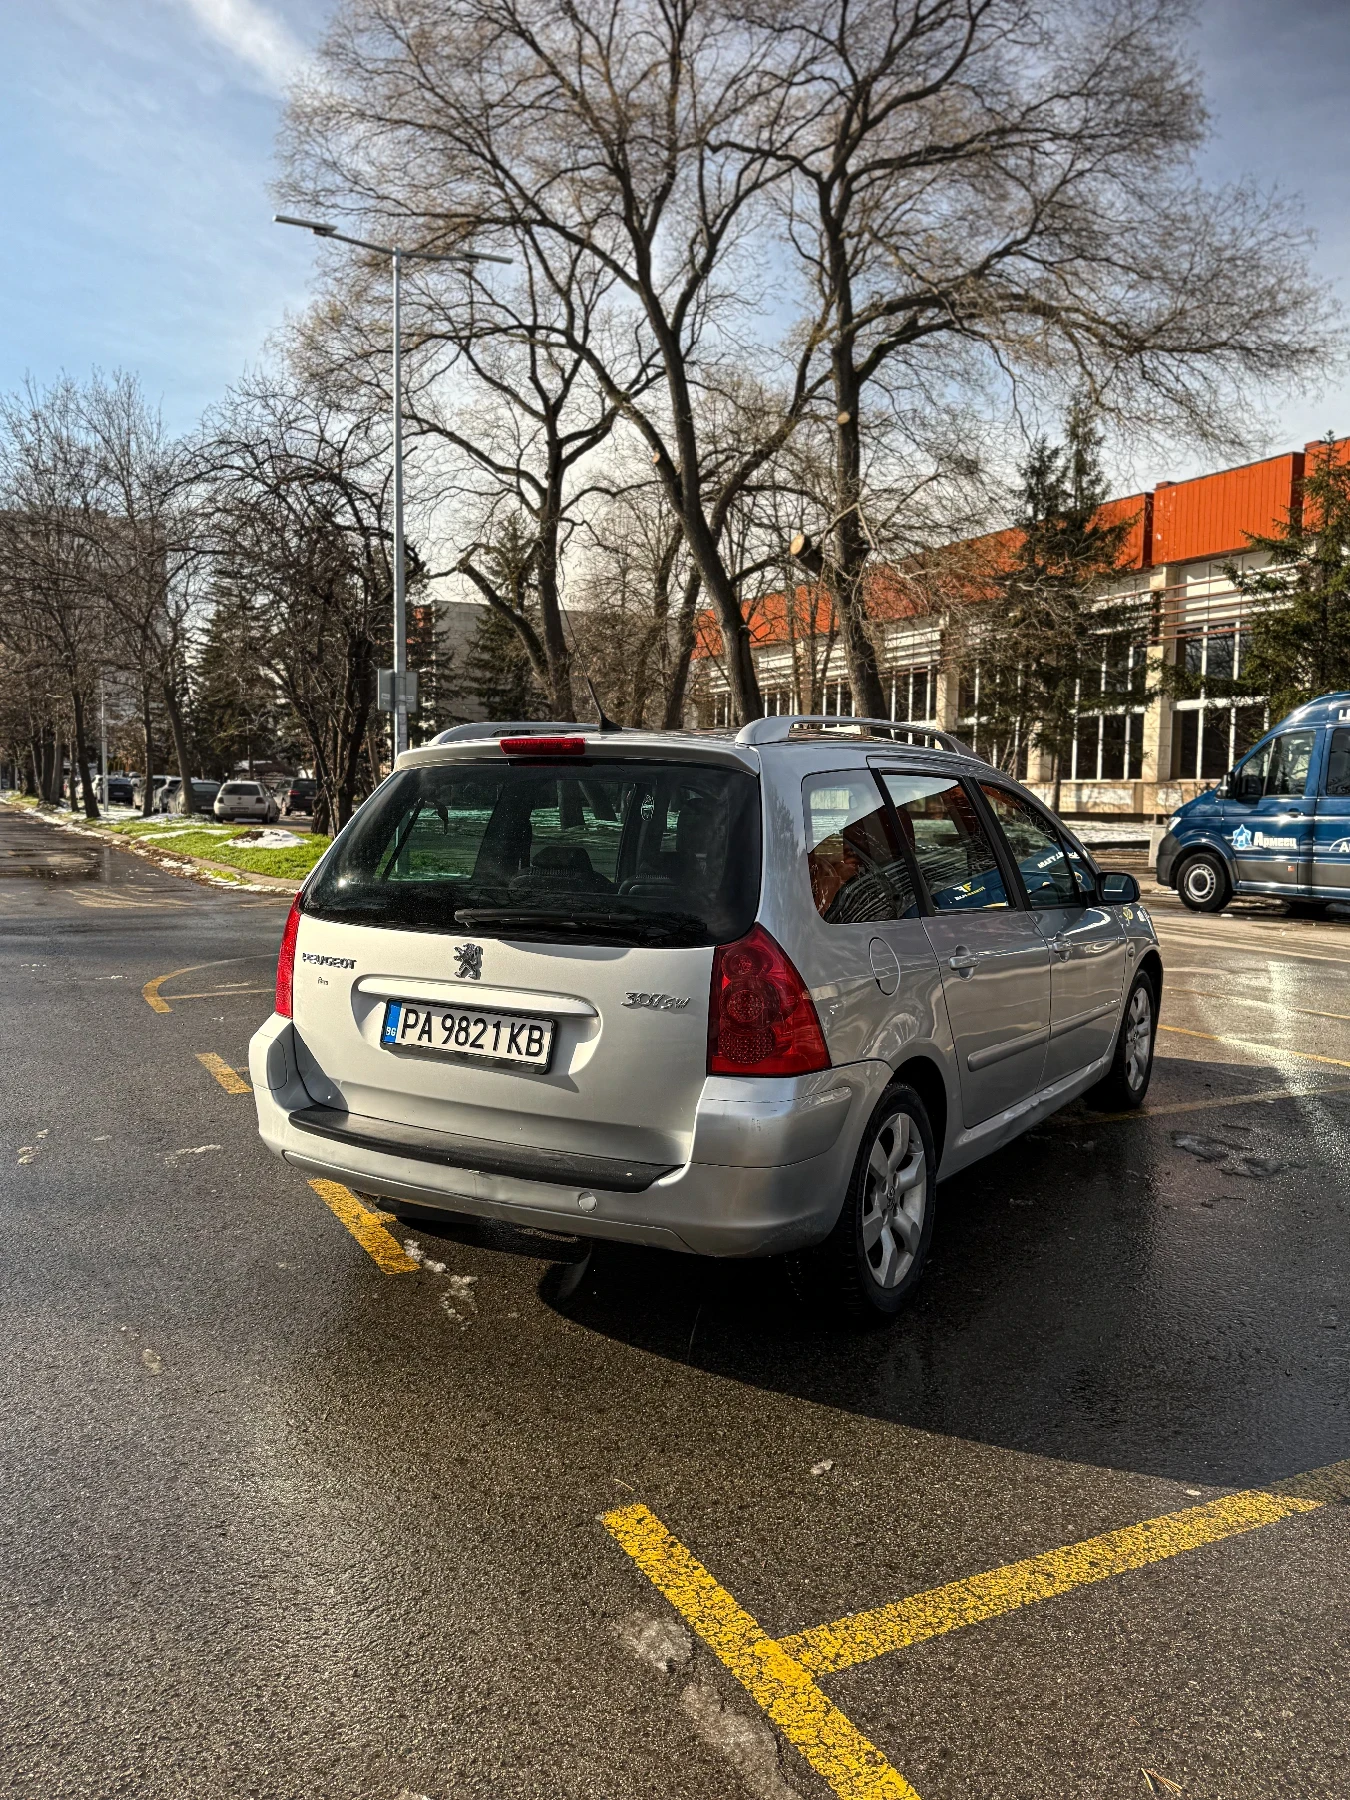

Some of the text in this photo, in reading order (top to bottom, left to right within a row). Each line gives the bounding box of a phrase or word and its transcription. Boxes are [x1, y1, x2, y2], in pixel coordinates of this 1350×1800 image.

[302, 952, 357, 969] PEUGEOT
[620, 991, 666, 1008] 307
[385, 1026, 398, 1037] BG
[400, 1008, 545, 1057] PA 9821 KB
